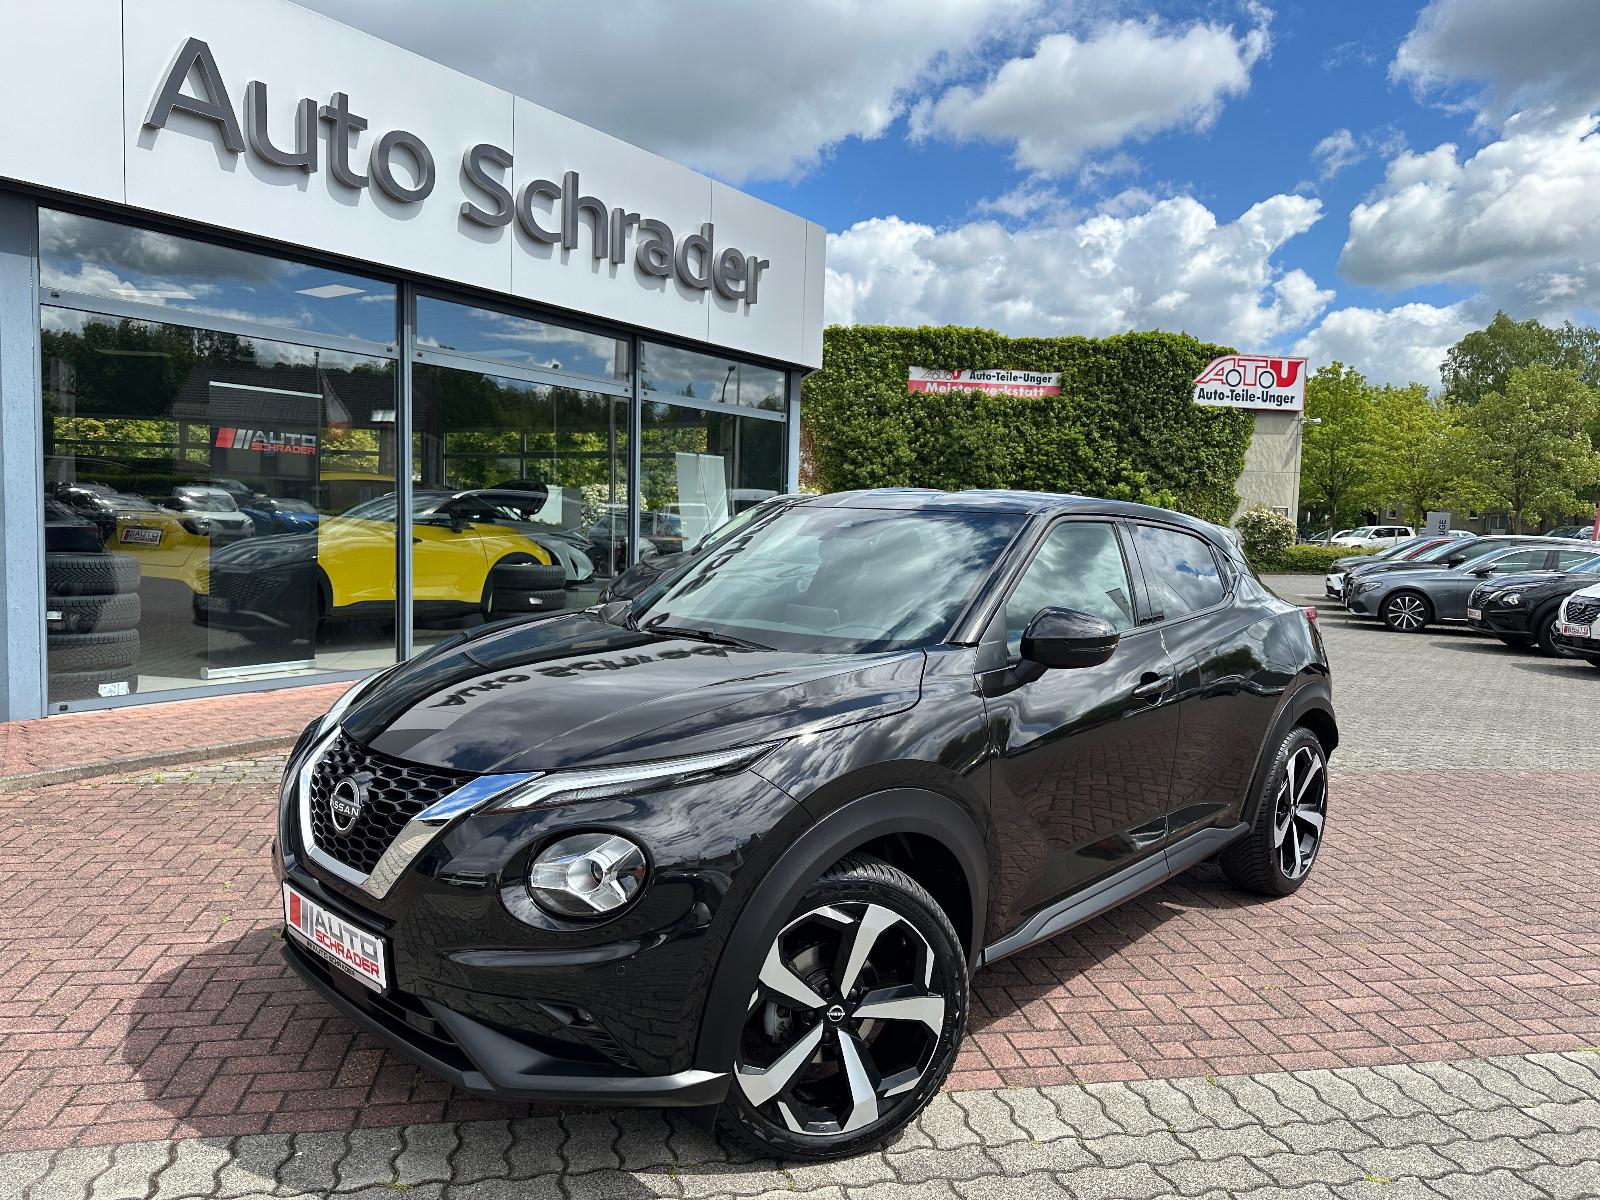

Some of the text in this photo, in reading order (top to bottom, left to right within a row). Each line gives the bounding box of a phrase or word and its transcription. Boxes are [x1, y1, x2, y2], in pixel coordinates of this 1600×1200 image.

[144, 36, 769, 305] Auto Schrader
[969, 370, 1052, 385] Auto-Teile-Unger
[925, 382, 1045, 397] Meisteekstatt
[1197, 387, 1296, 406] Auto-Teile-Unger
[252, 430, 316, 447] AUTO
[251, 442, 316, 455] SCHRADER
[333, 800, 359, 817] SSAN
[314, 909, 379, 963] AUTO
[314, 927, 380, 979] SCHRADER
